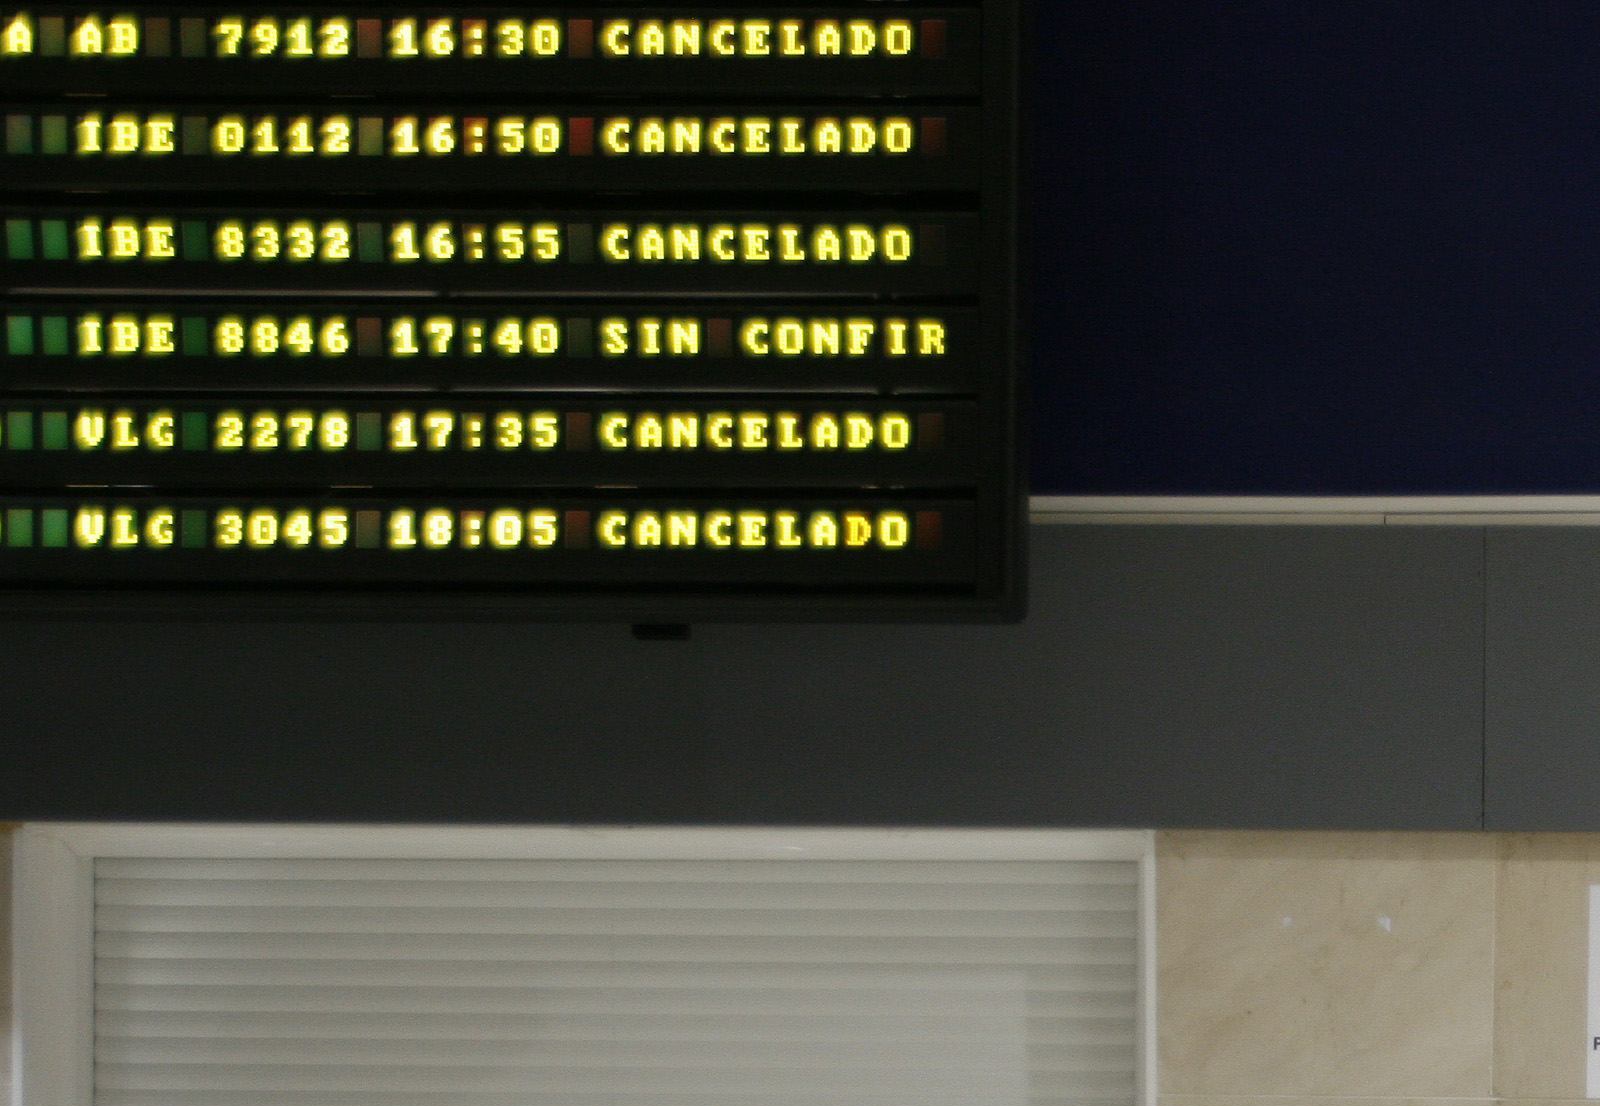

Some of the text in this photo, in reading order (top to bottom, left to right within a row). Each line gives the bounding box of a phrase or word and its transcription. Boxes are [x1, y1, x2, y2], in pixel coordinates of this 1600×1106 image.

[73, 17, 137, 54] AB
[215, 18, 349, 55] 7912
[391, 18, 559, 56] 16:30
[602, 20, 911, 55] CANCELADO
[79, 115, 911, 153] IBE 0112 16:50 CANCELADO
[79, 220, 911, 261] IBE 8332 16:55 CANCELADO
[80, 316, 945, 355] IBE 8846 17:40 SIN CONFIR
[75, 412, 909, 448] VLG 2278 17:35 CANCELADO
[75, 509, 908, 547] VLG 3045 18:05 CANCELADO
